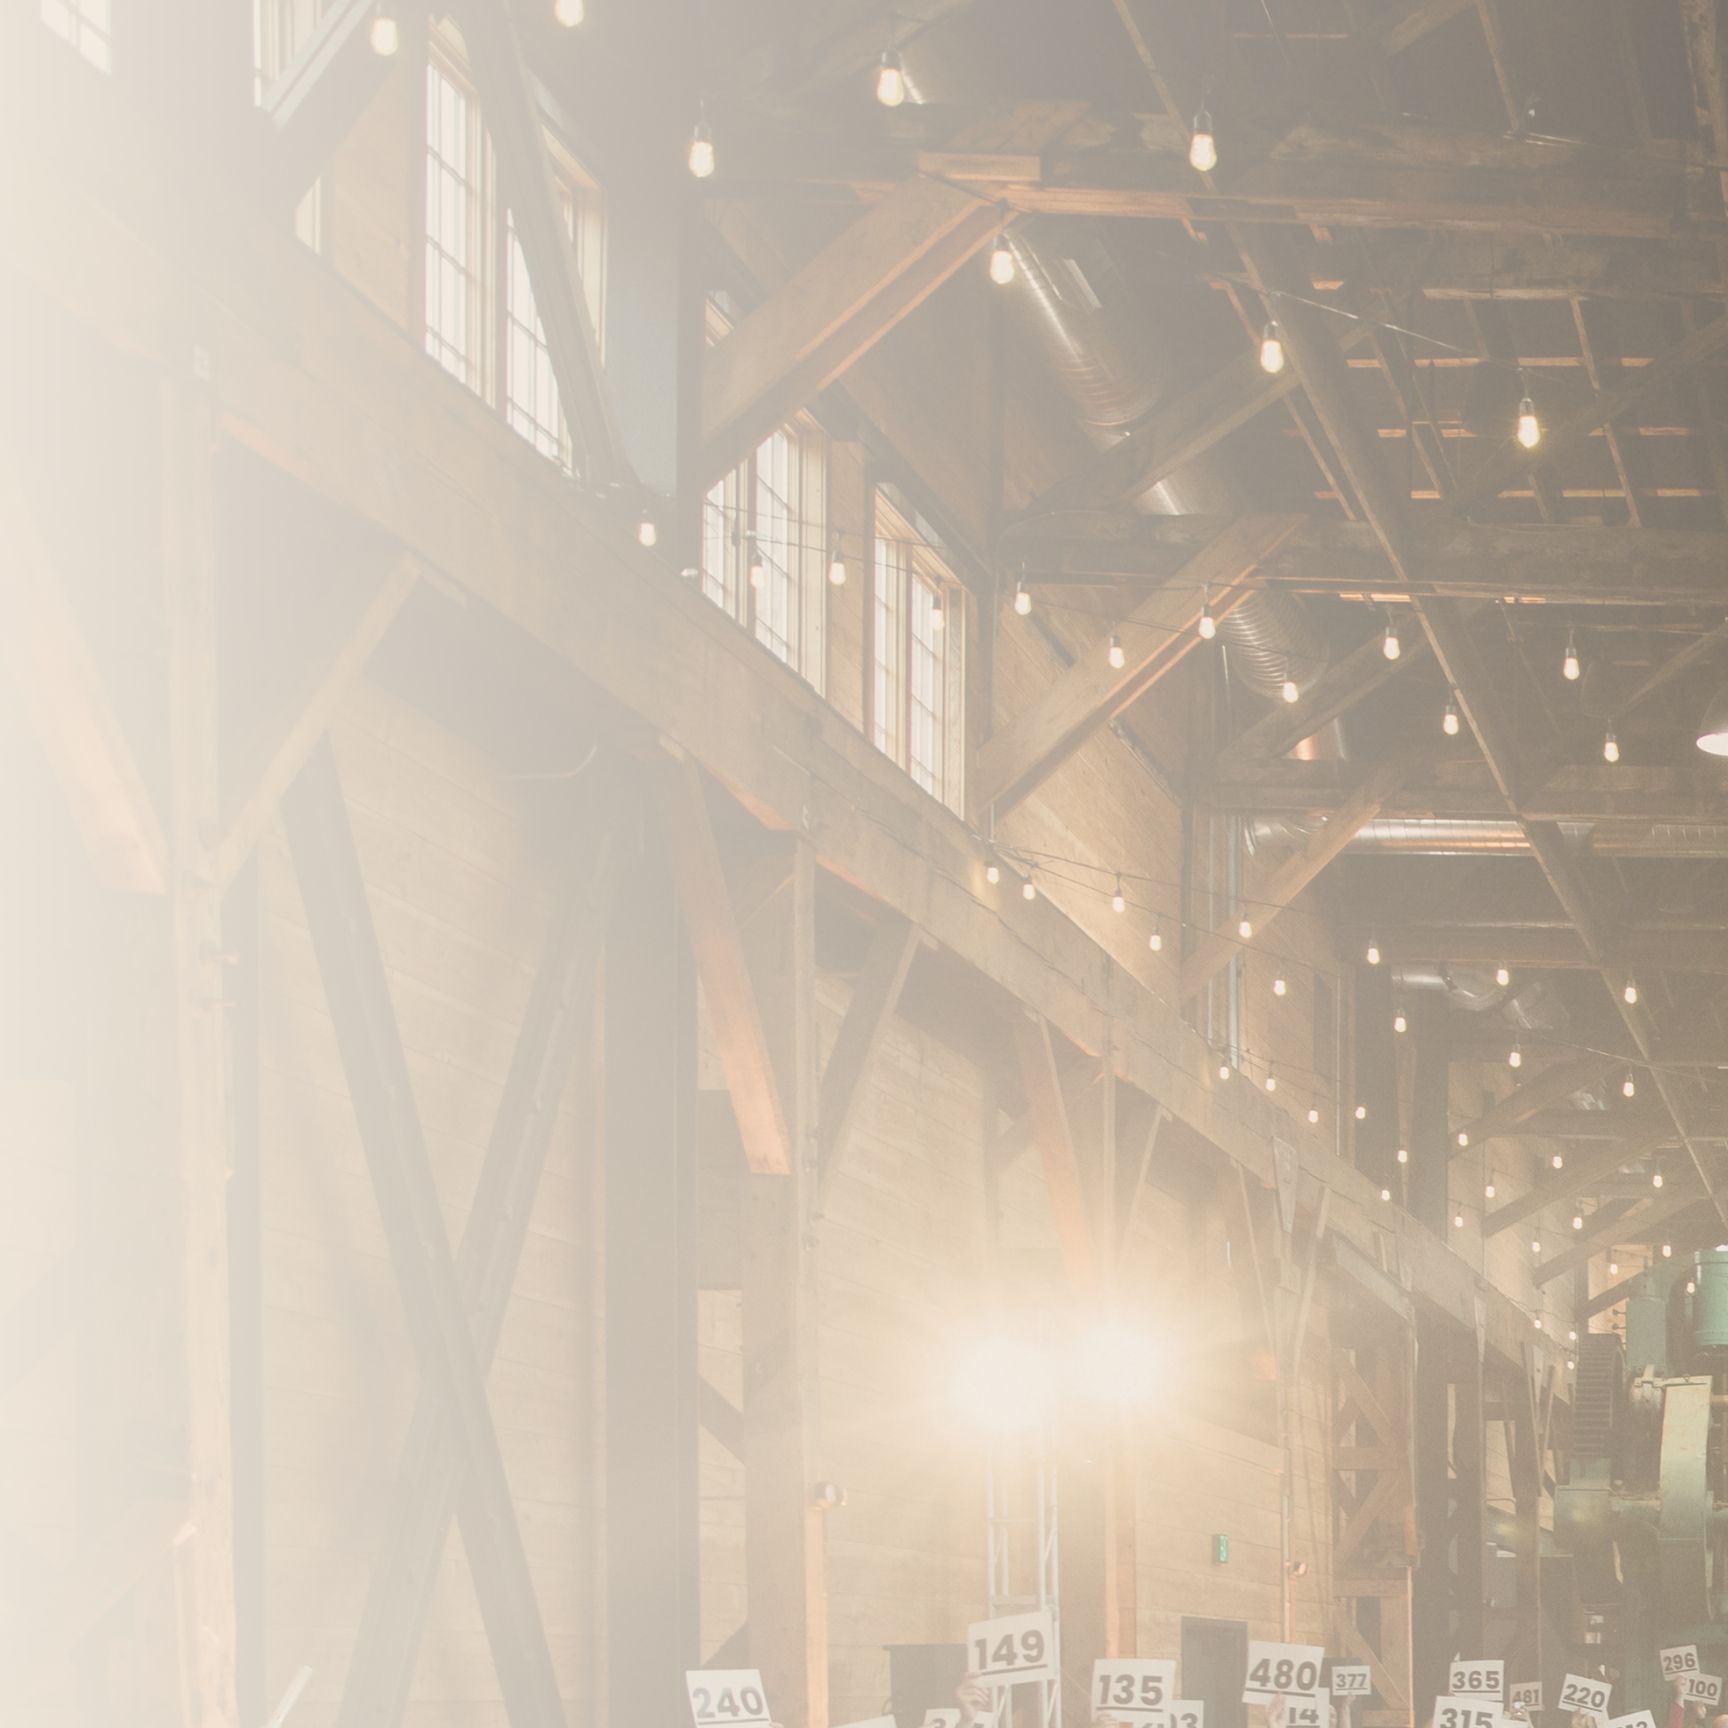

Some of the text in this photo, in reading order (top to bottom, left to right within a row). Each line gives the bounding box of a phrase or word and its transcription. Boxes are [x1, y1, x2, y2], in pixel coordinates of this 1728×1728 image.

[975, 1630, 1044, 1670] 149
[1664, 1653, 1696, 1672] 296
[1250, 1658, 1318, 1691] 480
[1336, 1673, 1367, 1689] 377
[1452, 1670, 1500, 1690] 365
[1098, 1674, 1162, 1705] 135
[1564, 1684, 1605, 1708] 220
[1688, 1678, 1717, 1697] 100
[692, 1686, 764, 1718] 240
[1288, 1707, 1319, 1724] 14
